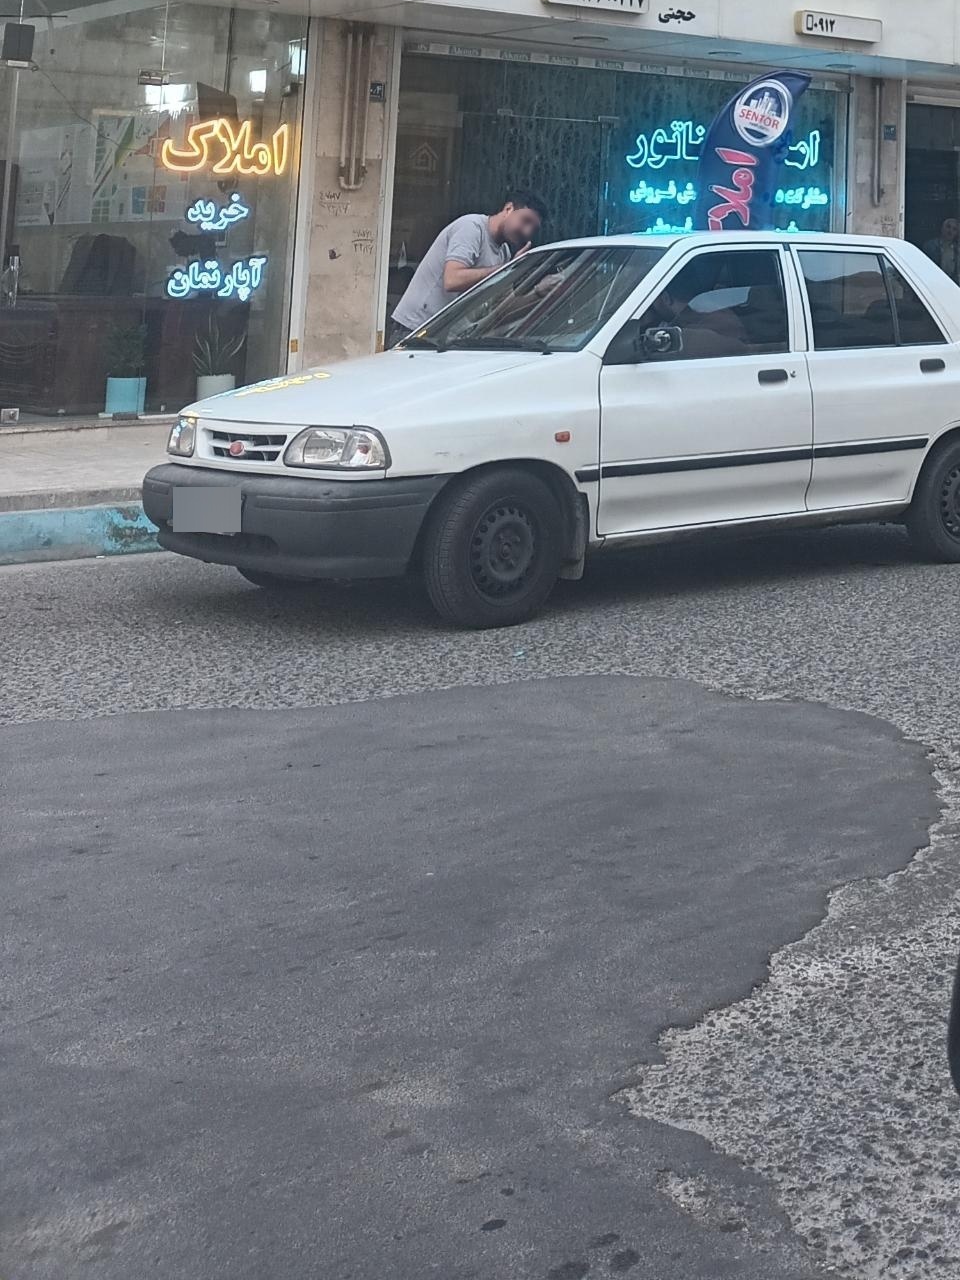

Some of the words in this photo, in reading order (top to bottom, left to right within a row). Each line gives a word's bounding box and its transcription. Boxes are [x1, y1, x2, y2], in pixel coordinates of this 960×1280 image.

[658, 8, 696, 25] حجتی
[738, 108, 780, 130] SENTOR
[161, 117, 290, 176] املاک
[626, 120, 707, 168] ناتور
[187, 192, 250, 231] خرید
